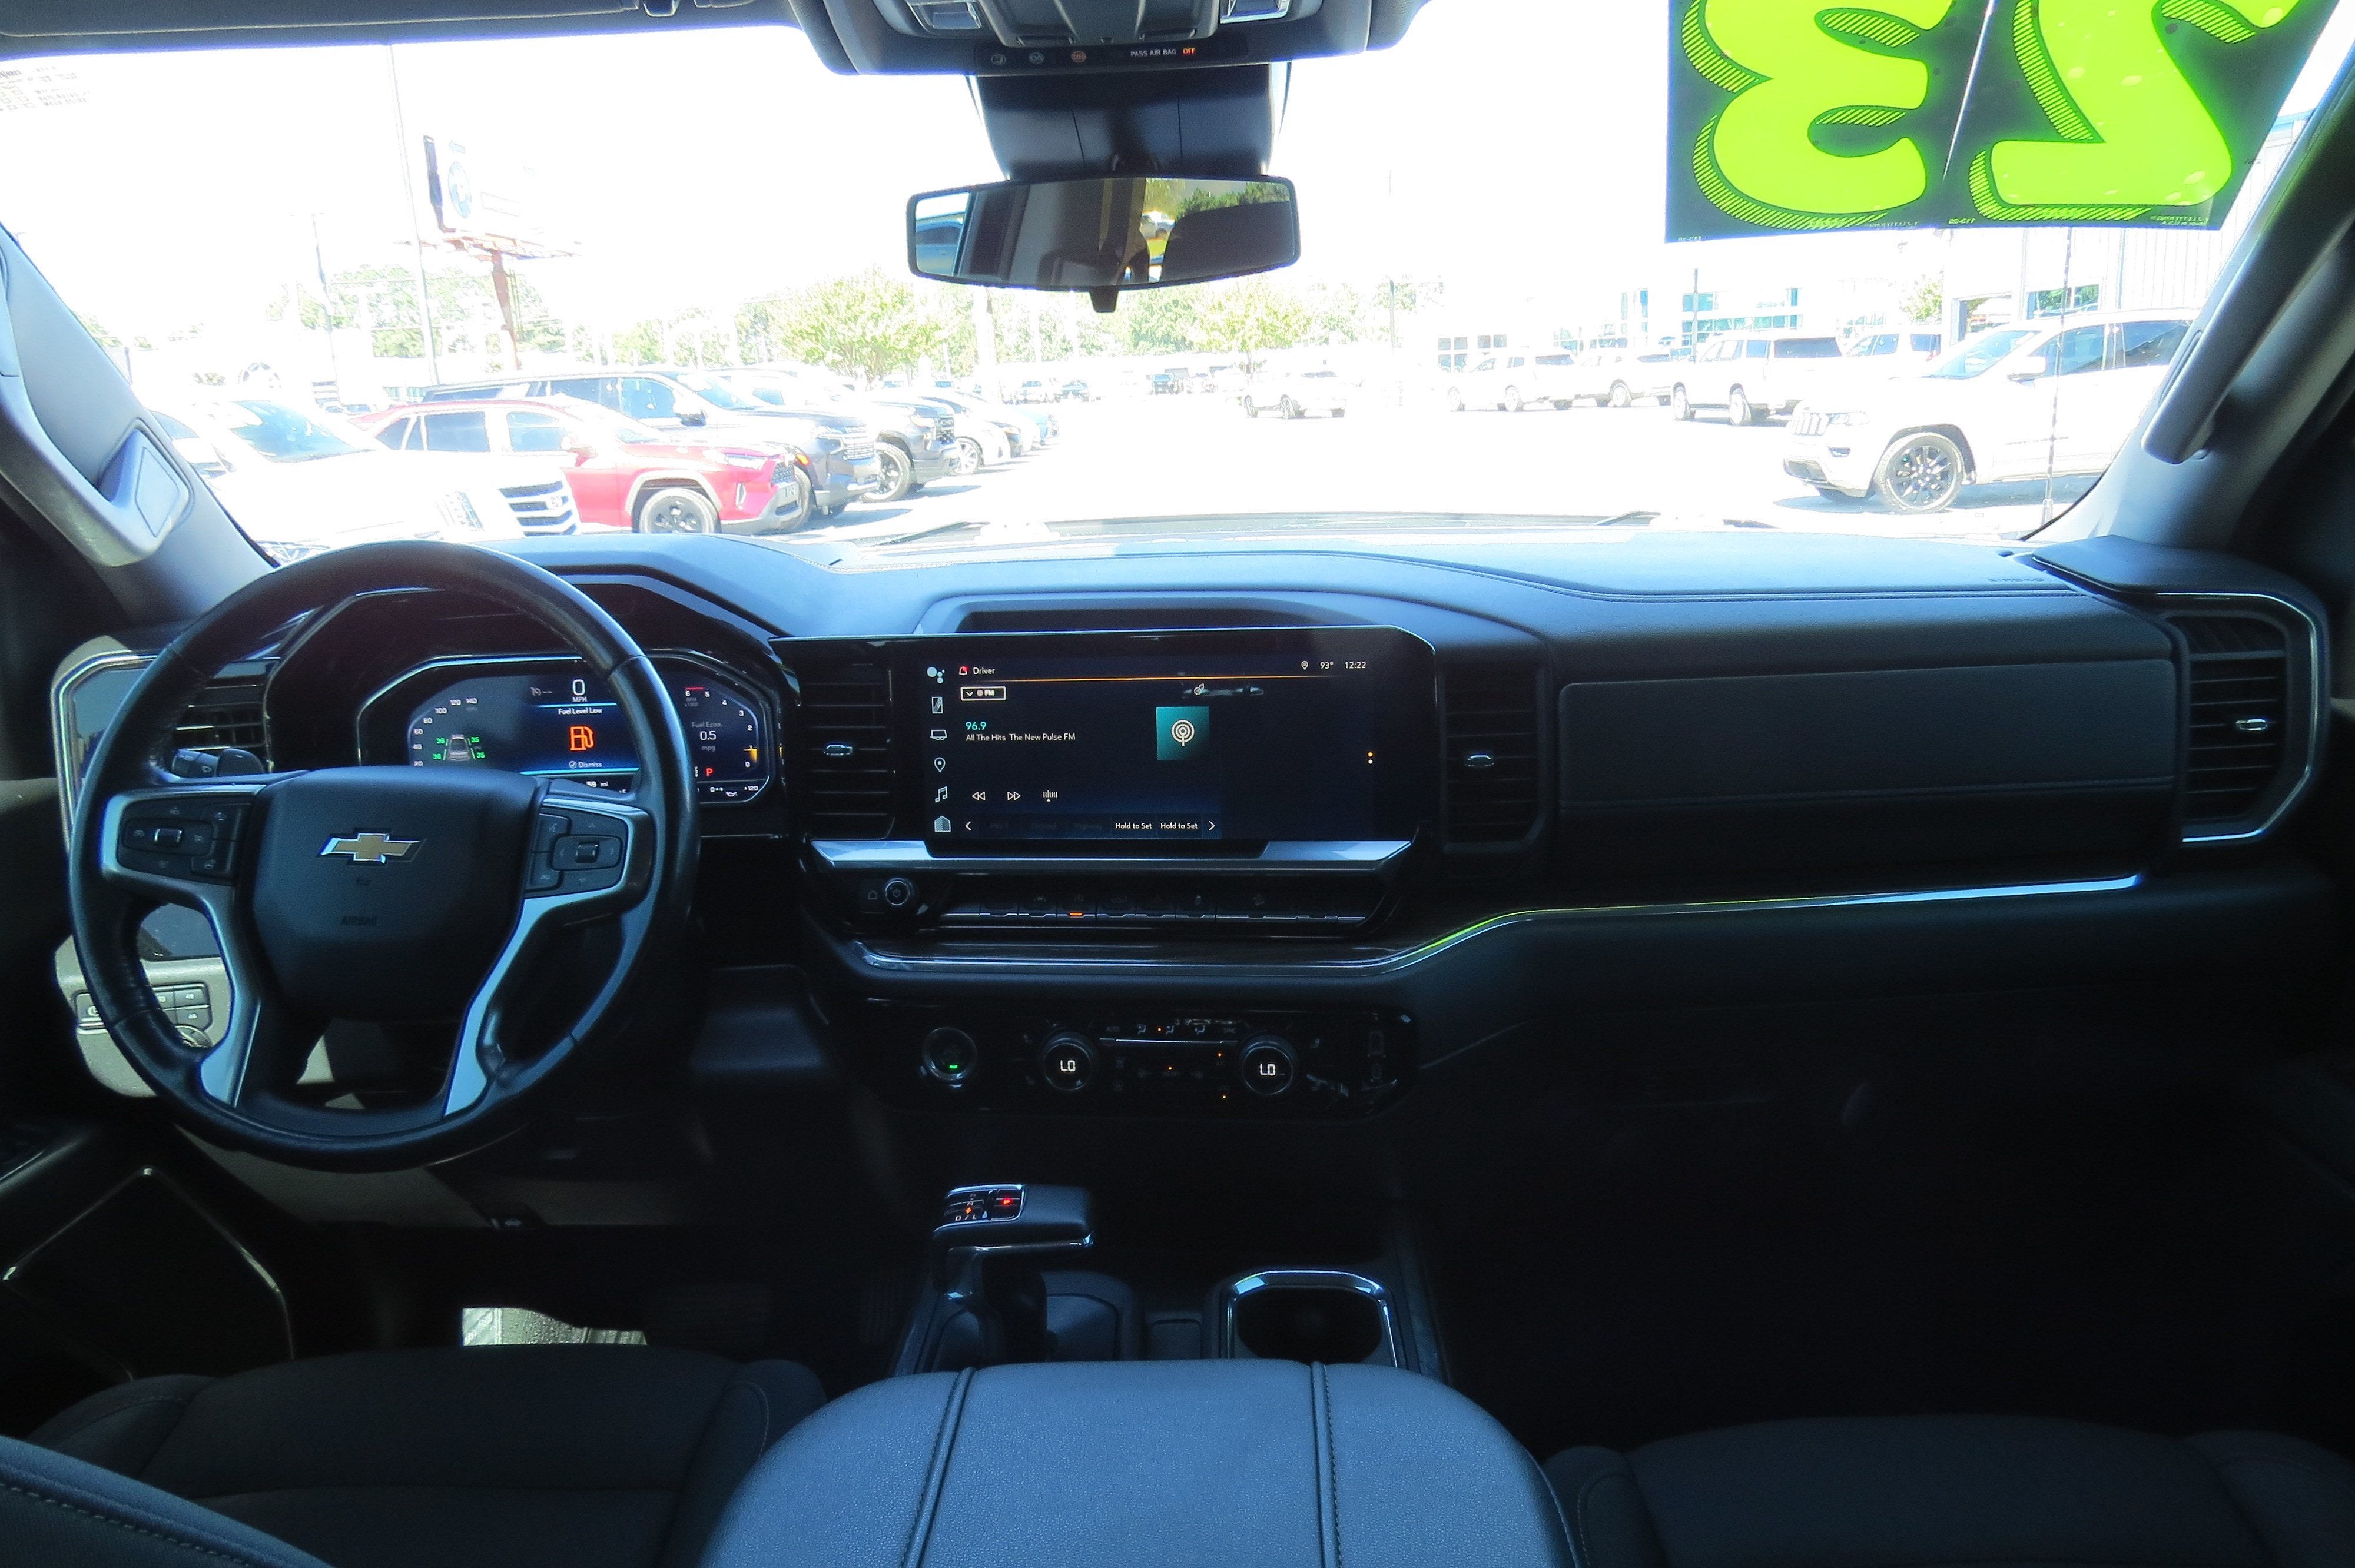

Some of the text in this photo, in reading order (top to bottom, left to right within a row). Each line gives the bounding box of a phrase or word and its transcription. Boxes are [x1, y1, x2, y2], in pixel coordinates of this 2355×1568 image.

[973, 667, 995, 675] Driver
[572, 679, 585, 696] 0
[966, 721, 987, 730] 96.9
[699, 730, 717, 740] 0.5
[706, 768, 714, 776] P
